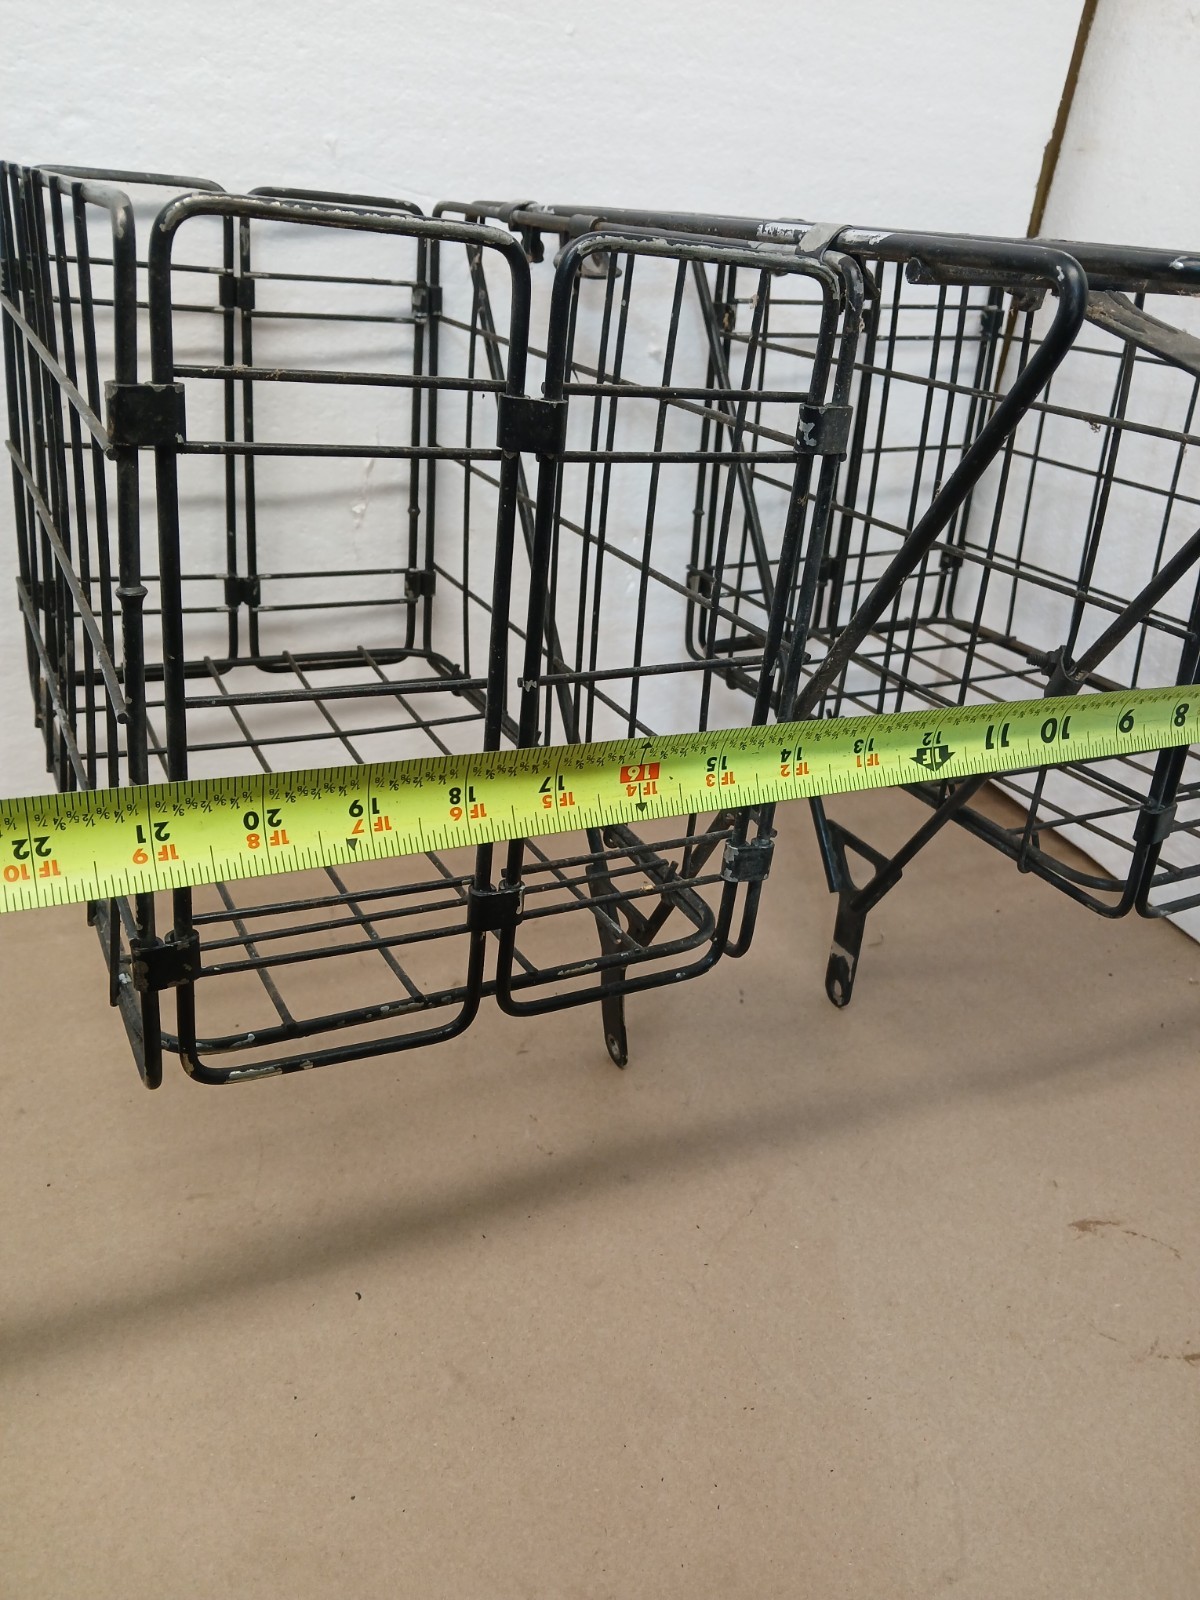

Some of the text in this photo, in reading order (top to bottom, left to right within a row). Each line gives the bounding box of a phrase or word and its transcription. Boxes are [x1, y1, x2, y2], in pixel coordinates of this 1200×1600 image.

[1119, 709, 1135, 733] 9
[1174, 703, 1189, 727] 8
[922, 731, 941, 746] 12
[986, 723, 1010, 749] 11
[1041, 716, 1071, 744] 10
[781, 747, 802, 762] 14
[854, 738, 874, 753] 13
[707, 756, 727, 772] 15
[856, 754, 879, 767] 1F 1
[922, 747, 942, 764] 1F
[628, 765, 650, 780] 16
[781, 762, 809, 777] 1F 2
[539, 775, 565, 793] 17
[706, 772, 735, 787] 1F 3
[449, 786, 476, 804] 18
[626, 781, 657, 797] 1F 4
[349, 798, 380, 817] 19
[542, 792, 575, 808] 1F 5
[243, 808, 282, 830] 20
[450, 803, 487, 821] 1F 6
[136, 821, 170, 844] 21
[352, 816, 392, 834] 1F 7
[12, 836, 52, 860] 22
[246, 830, 289, 849] 1F 8
[133, 844, 179, 864] 1F 9
[4, 860, 61, 882] 1F 10
